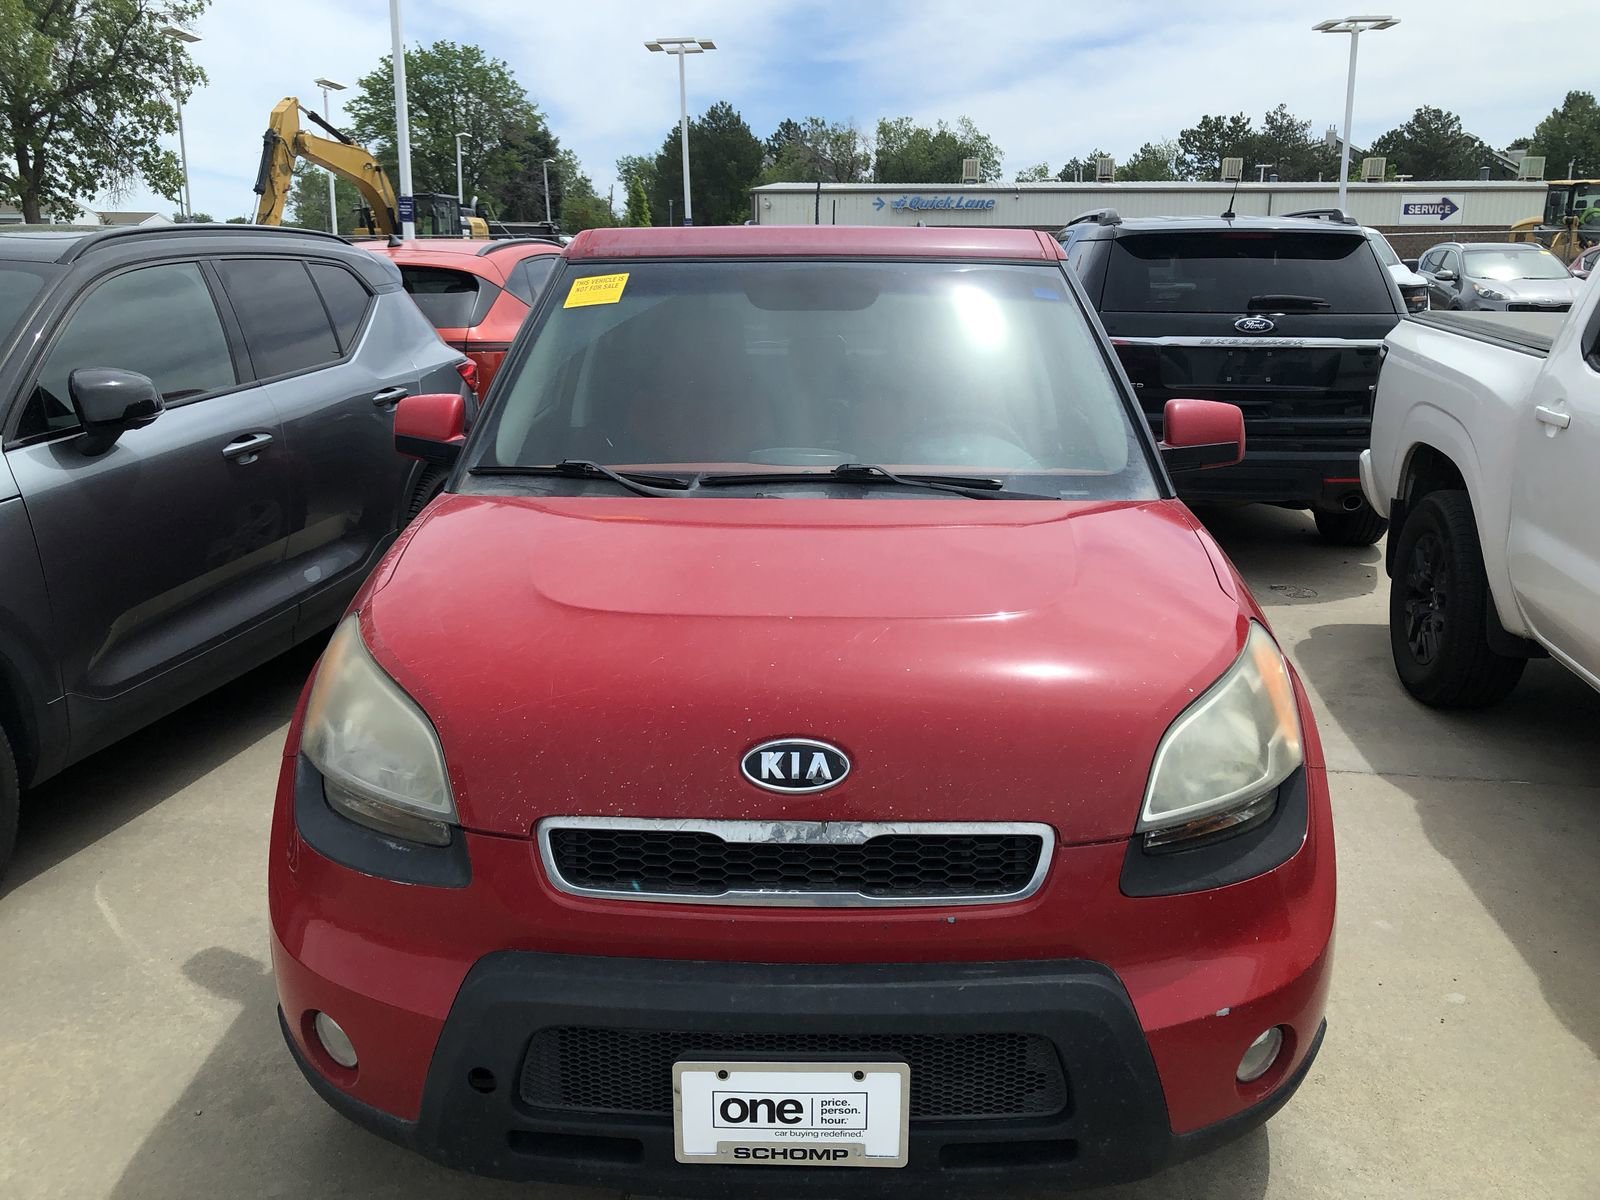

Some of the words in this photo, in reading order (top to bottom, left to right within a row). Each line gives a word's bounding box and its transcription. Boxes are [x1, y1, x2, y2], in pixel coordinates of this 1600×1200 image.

[909, 196, 954, 210] Quick
[956, 196, 996, 209] Lane
[1408, 204, 1451, 214] SERVICE
[591, 276, 618, 285] VEHICLE
[602, 282, 619, 290] SALE
[1243, 320, 1266, 330] Ford
[760, 751, 833, 780] KIA
[820, 1097, 851, 1108] price.
[719, 1097, 804, 1124] one
[820, 1107, 861, 1116] person.
[820, 1116, 848, 1125] hour.
[774, 1130, 788, 1138] car
[789, 1129, 819, 1138] buying
[820, 1130, 865, 1138] redefined.
[733, 1147, 849, 1161] SCHOMP
